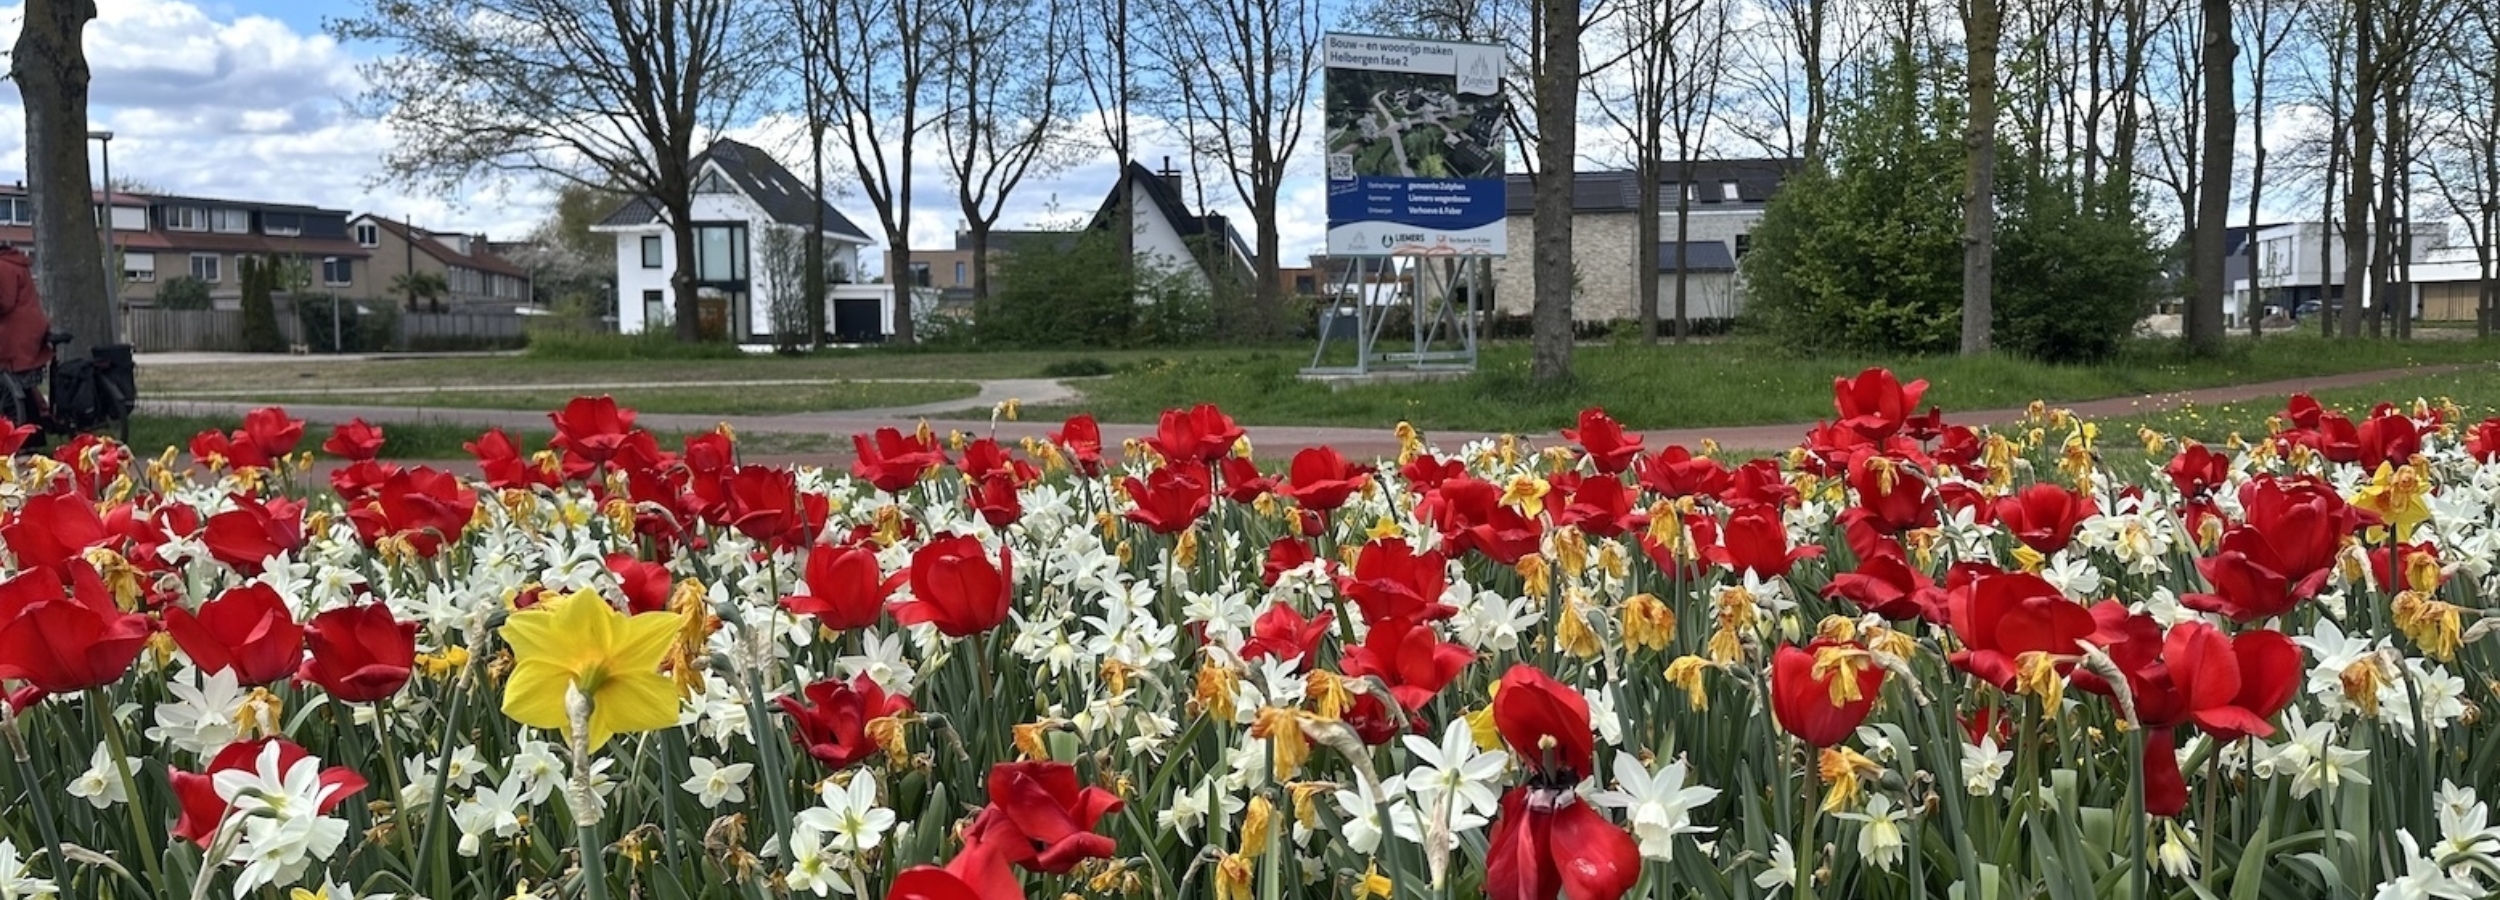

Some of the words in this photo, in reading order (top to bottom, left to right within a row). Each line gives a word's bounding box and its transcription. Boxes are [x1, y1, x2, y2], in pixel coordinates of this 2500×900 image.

[1330, 38, 1357, 49] Bouw
[1366, 42, 1378, 50] en
[1380, 42, 1421, 56] woonrijp
[1423, 45, 1453, 56] maken
[1330, 51, 1379, 66] Helbergen
[1381, 55, 1400, 66] fase
[1402, 56, 1409, 67] 2
[1461, 75, 1494, 89] Zutphen
[1408, 183, 1439, 191] gemeente
[1440, 182, 1466, 192] Zutphen
[1408, 194, 1434, 202] Liemers
[1434, 195, 1471, 204] wegenbouw
[1408, 206, 1438, 215] Verhoeve
[1439, 207, 1444, 215] &
[1395, 233, 1425, 242] LIEMERS
